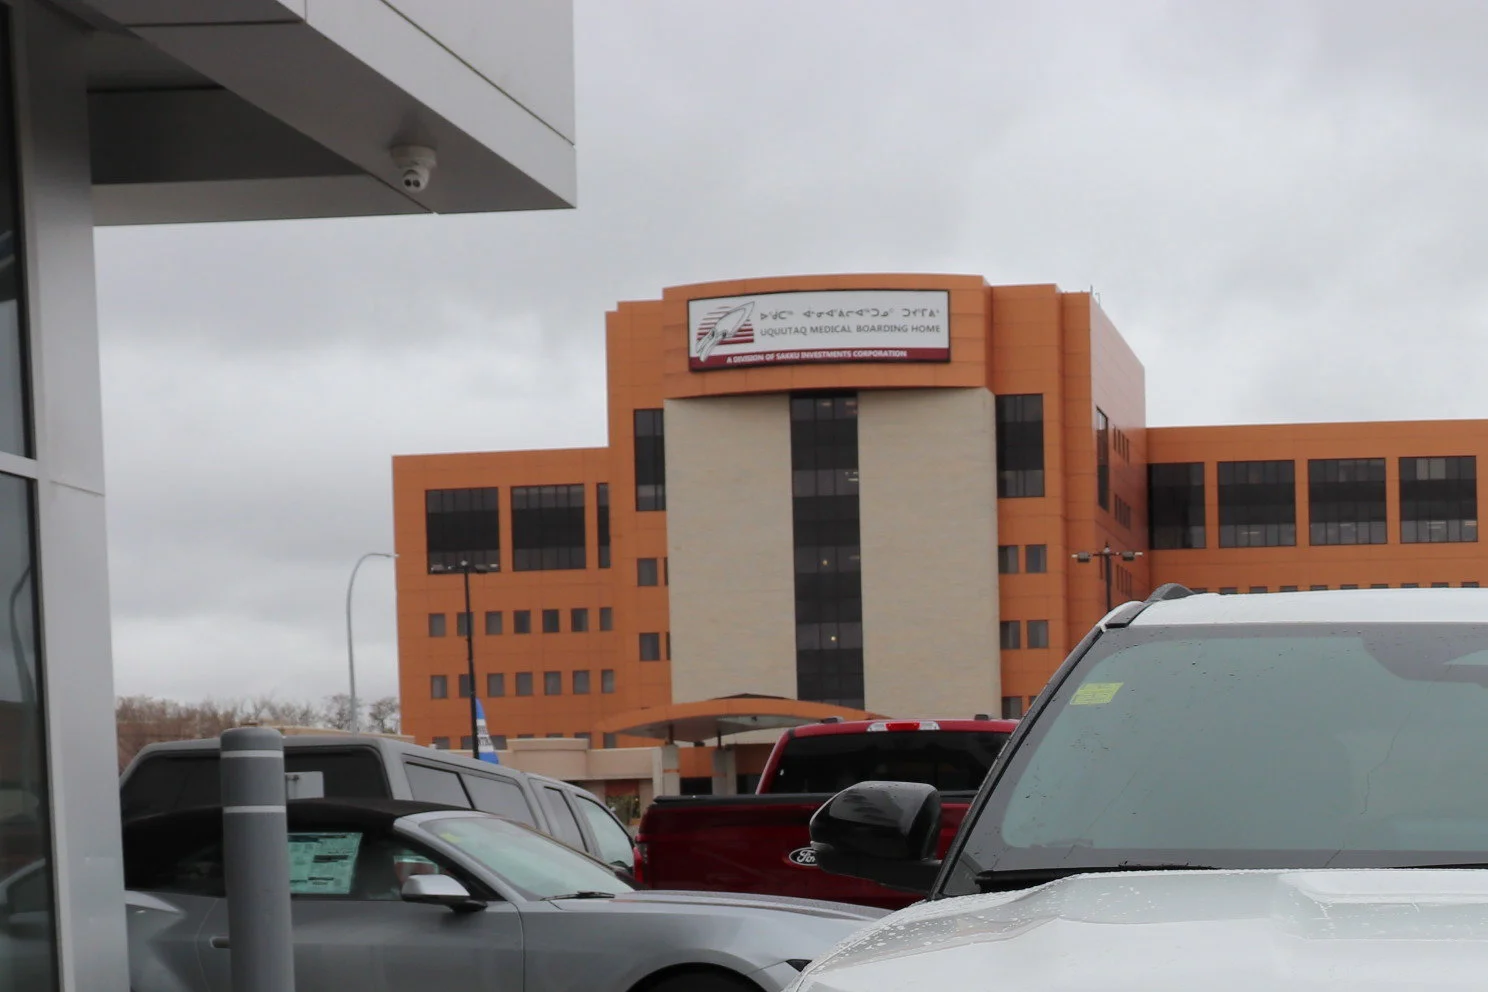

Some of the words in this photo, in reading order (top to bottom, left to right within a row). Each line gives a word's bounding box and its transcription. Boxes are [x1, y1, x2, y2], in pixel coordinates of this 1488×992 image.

[760, 326, 807, 338] UQUUTAQ
[810, 324, 852, 335] MEDICAL
[856, 324, 909, 334] BOARDING
[911, 324, 941, 334] HOME
[726, 355, 733, 364] A
[733, 354, 764, 363] DIVISION
[765, 353, 775, 362] OF
[801, 350, 852, 359] INVESTMENTS
[853, 349, 908, 358] CORPORATION
